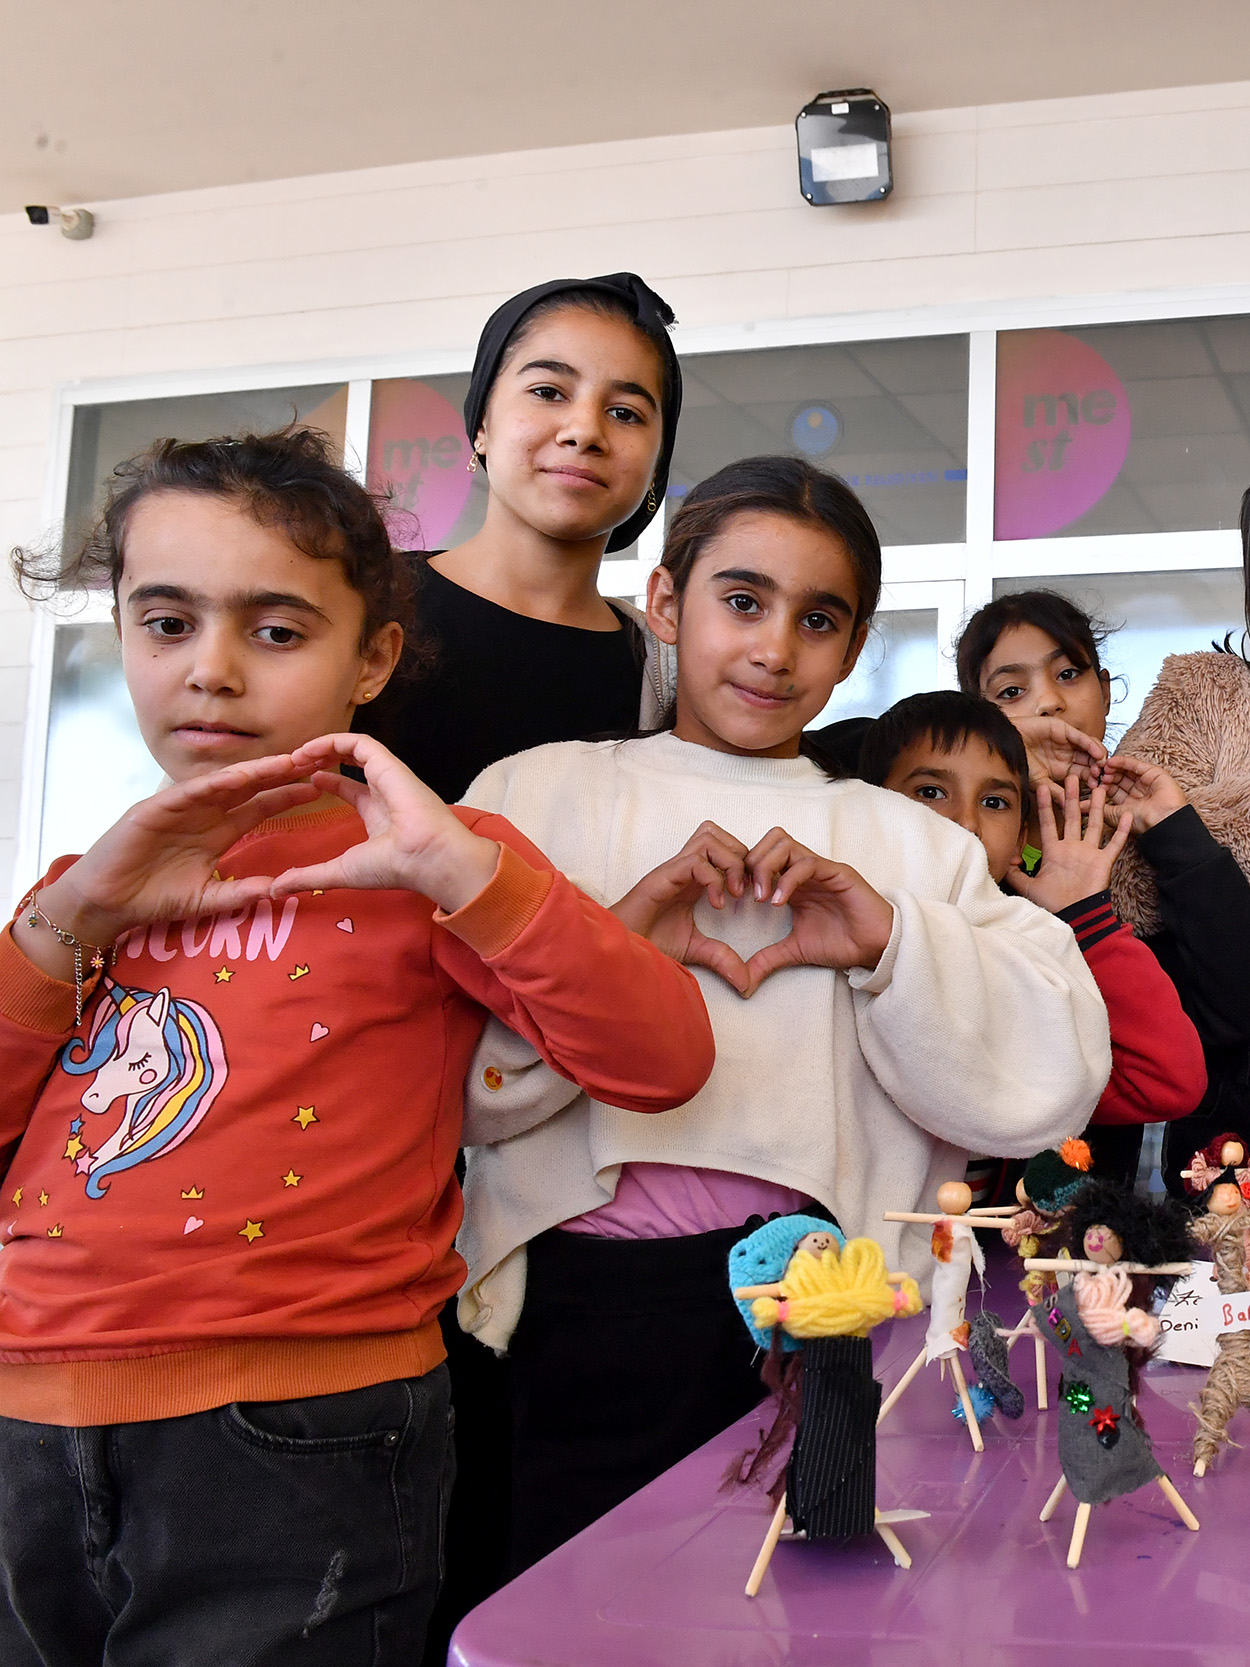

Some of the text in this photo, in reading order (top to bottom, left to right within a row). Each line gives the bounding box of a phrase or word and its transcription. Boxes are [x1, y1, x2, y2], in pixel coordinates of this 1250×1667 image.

[1024, 389, 1117, 428] me
[383, 435, 462, 474] me
[1021, 429, 1074, 473] st
[114, 896, 300, 962] ICORN
